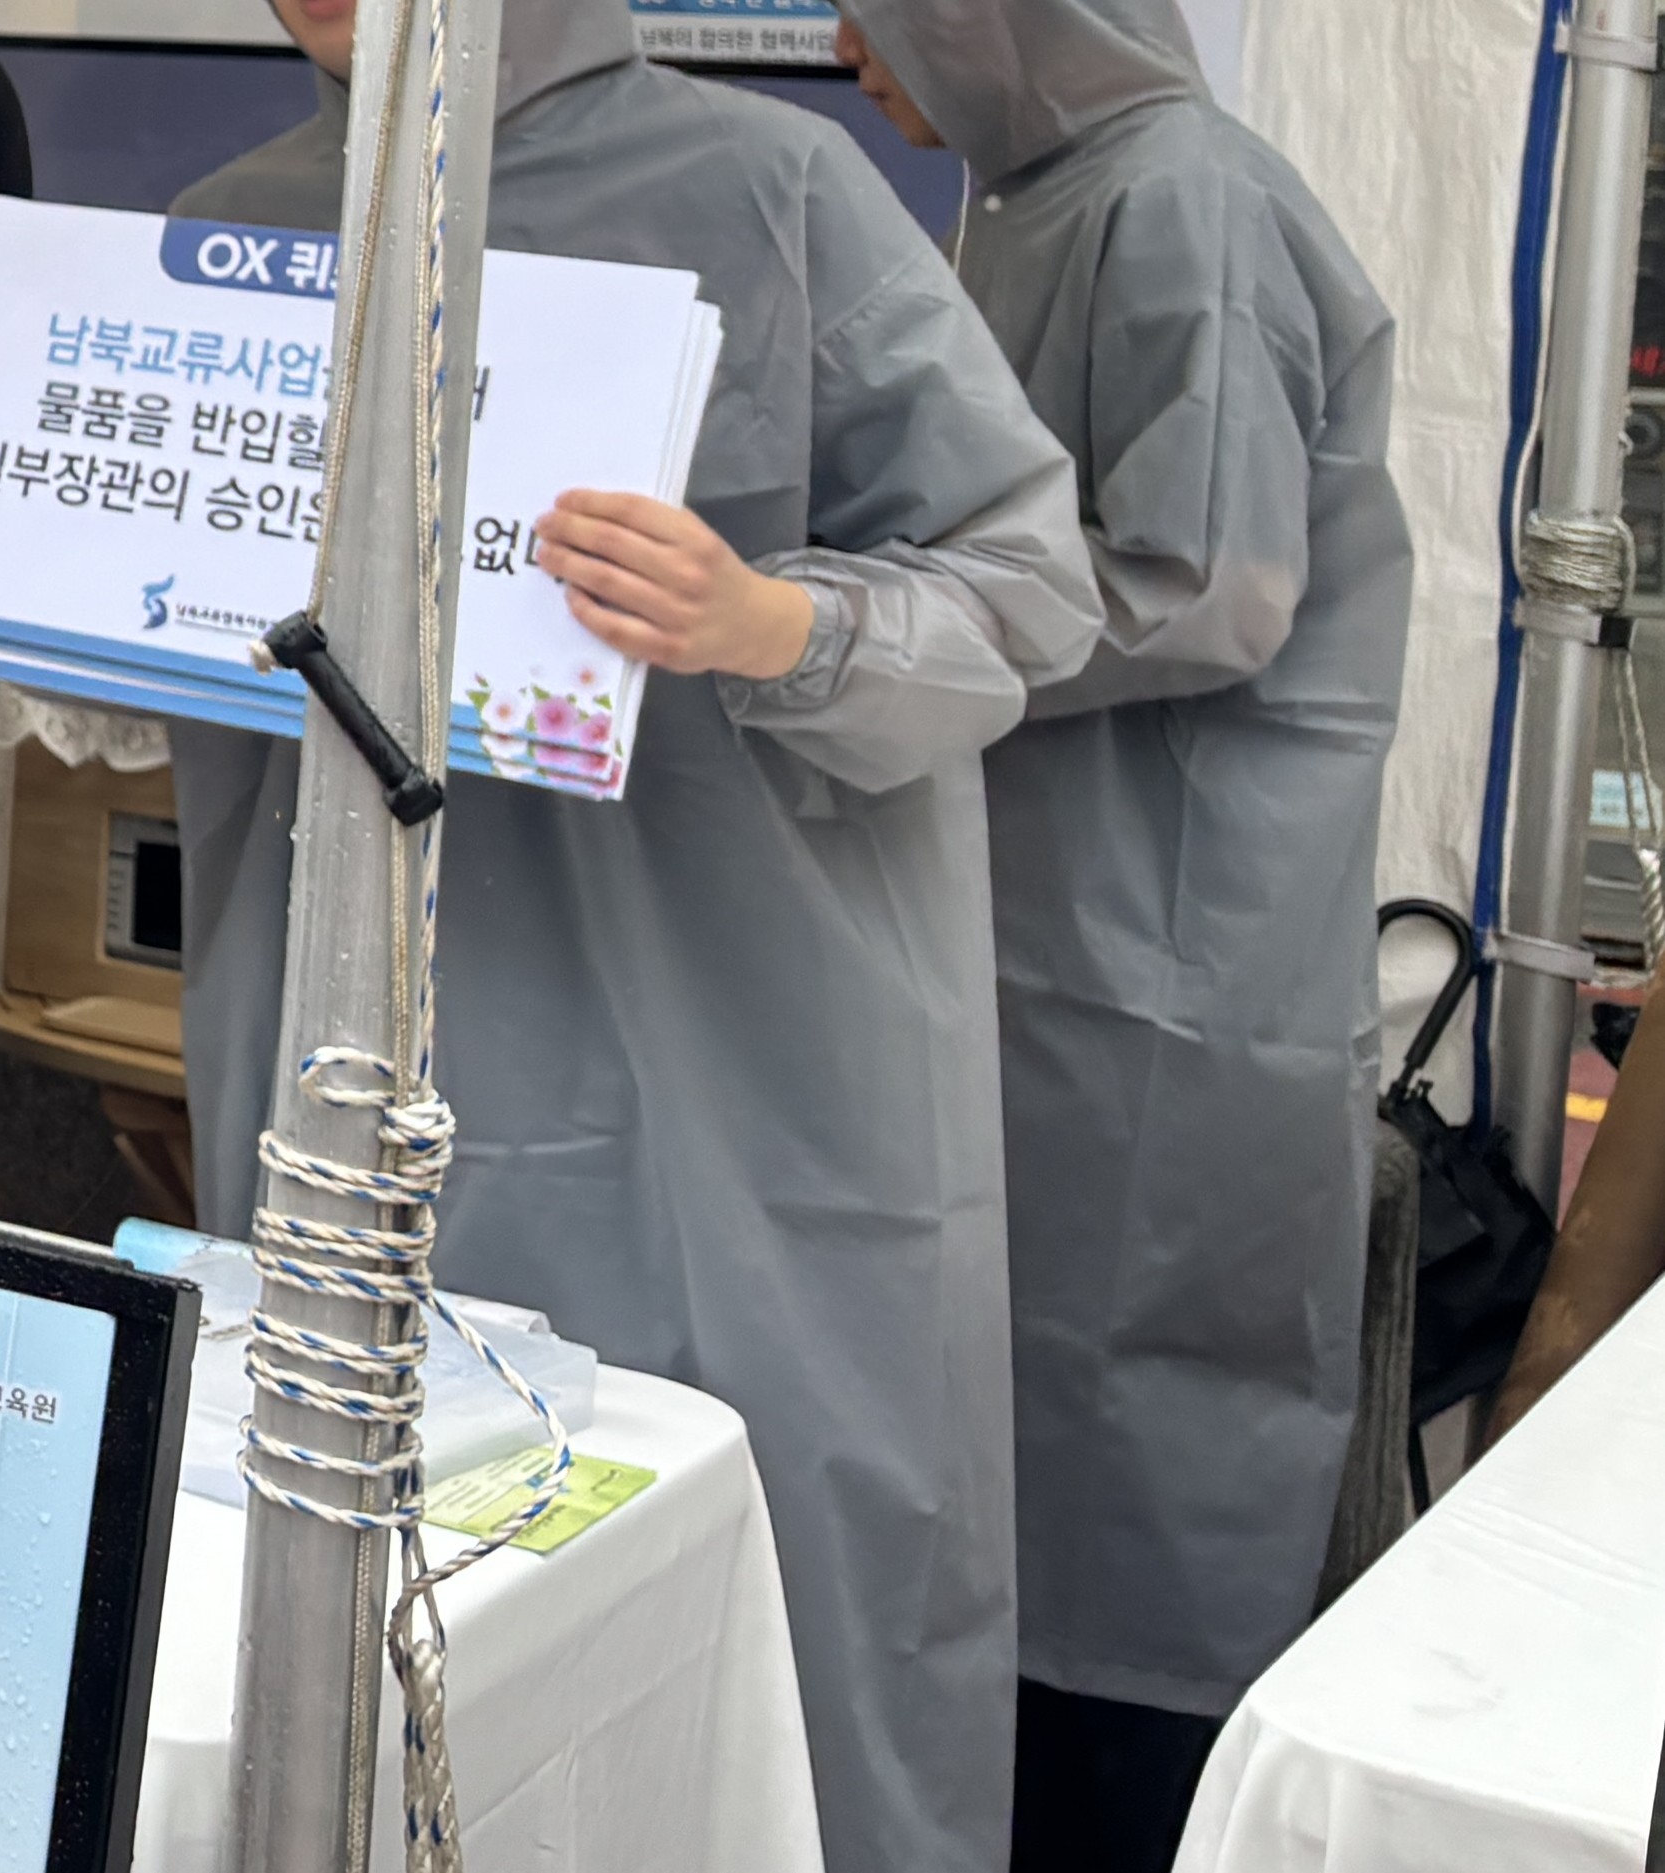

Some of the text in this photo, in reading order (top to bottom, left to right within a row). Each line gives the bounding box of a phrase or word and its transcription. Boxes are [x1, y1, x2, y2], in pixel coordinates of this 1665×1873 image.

[196, 232, 338, 292] OX 퀴
[47, 312, 333, 401] 남북교류사업
[37, 380, 175, 449] 물품을
